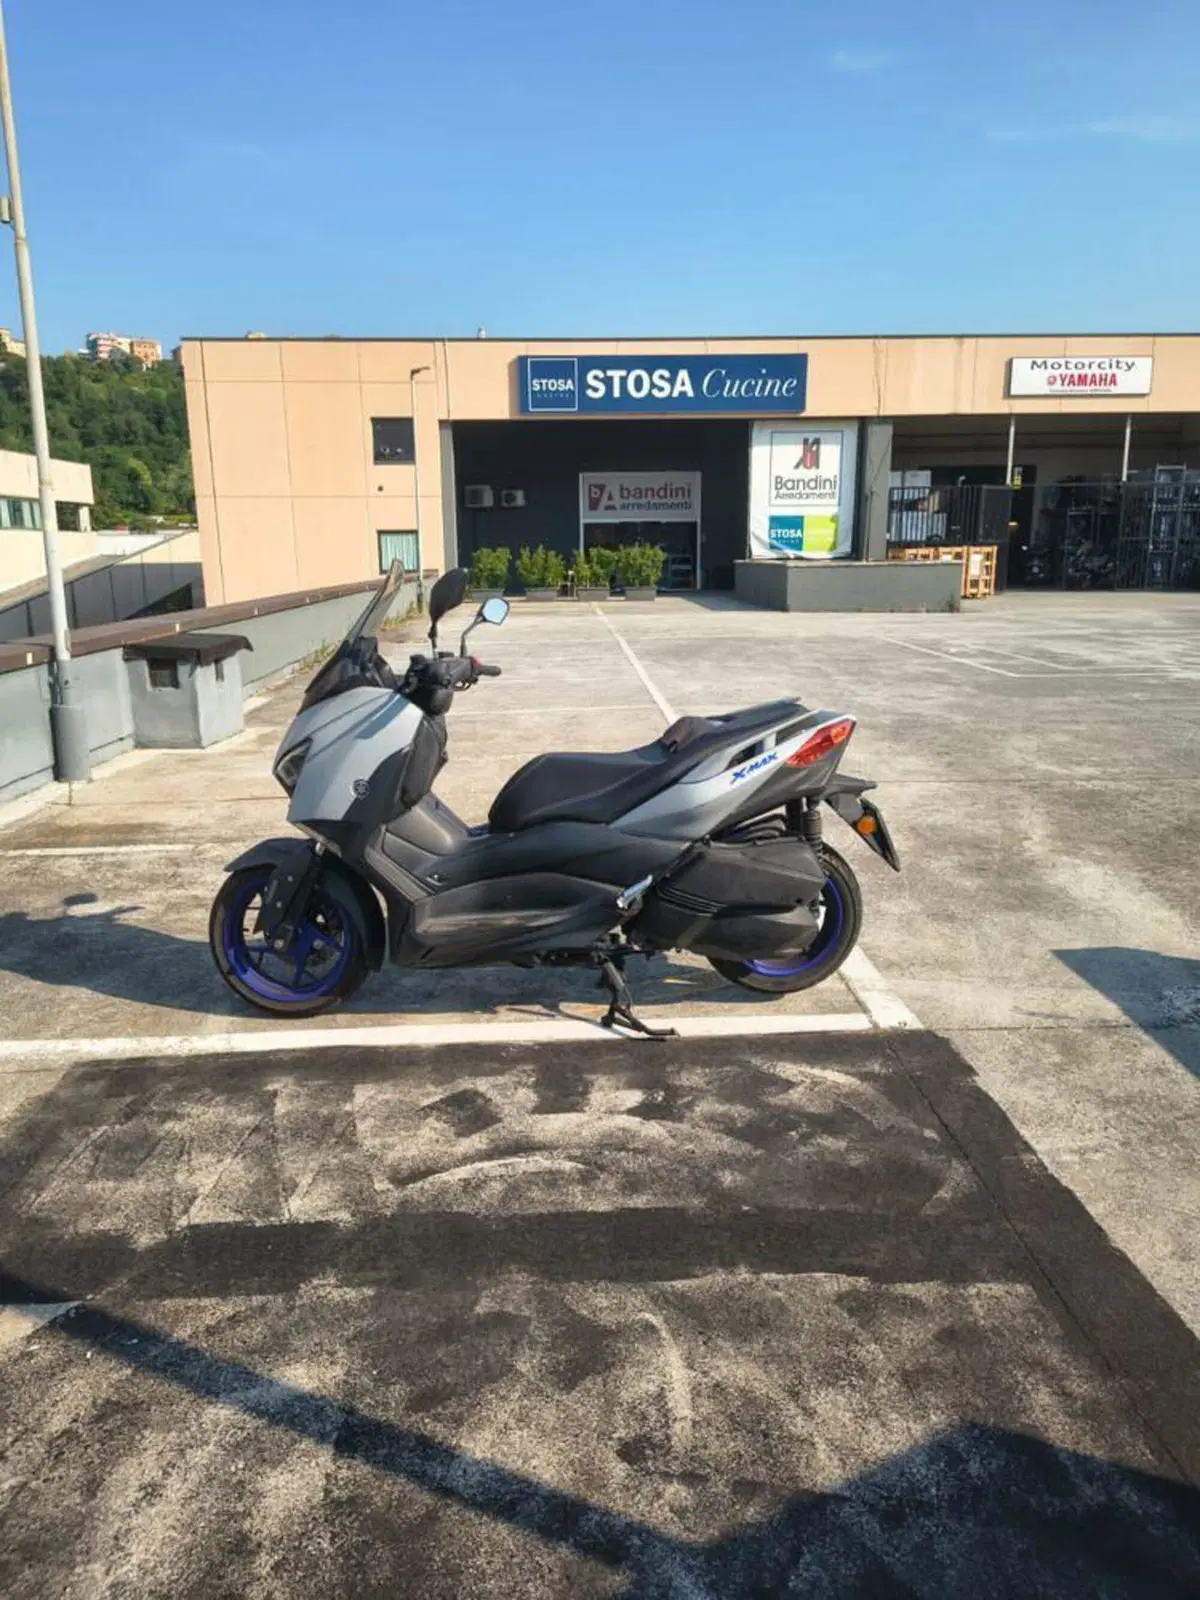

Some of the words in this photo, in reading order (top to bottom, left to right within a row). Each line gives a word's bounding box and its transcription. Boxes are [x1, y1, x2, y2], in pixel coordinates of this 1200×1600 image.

[1030, 359, 1136, 372] Motorcity
[531, 378, 574, 391] STOSA
[585, 369, 695, 399] STOSA
[702, 368, 798, 398] Cucine
[1060, 372, 1118, 387] YAMAHA
[774, 474, 838, 491] Bandini
[619, 481, 692, 499] bandini
[774, 491, 837, 500] Arredamenti
[619, 500, 692, 510] arredamenti
[770, 528, 803, 539] STOSA
